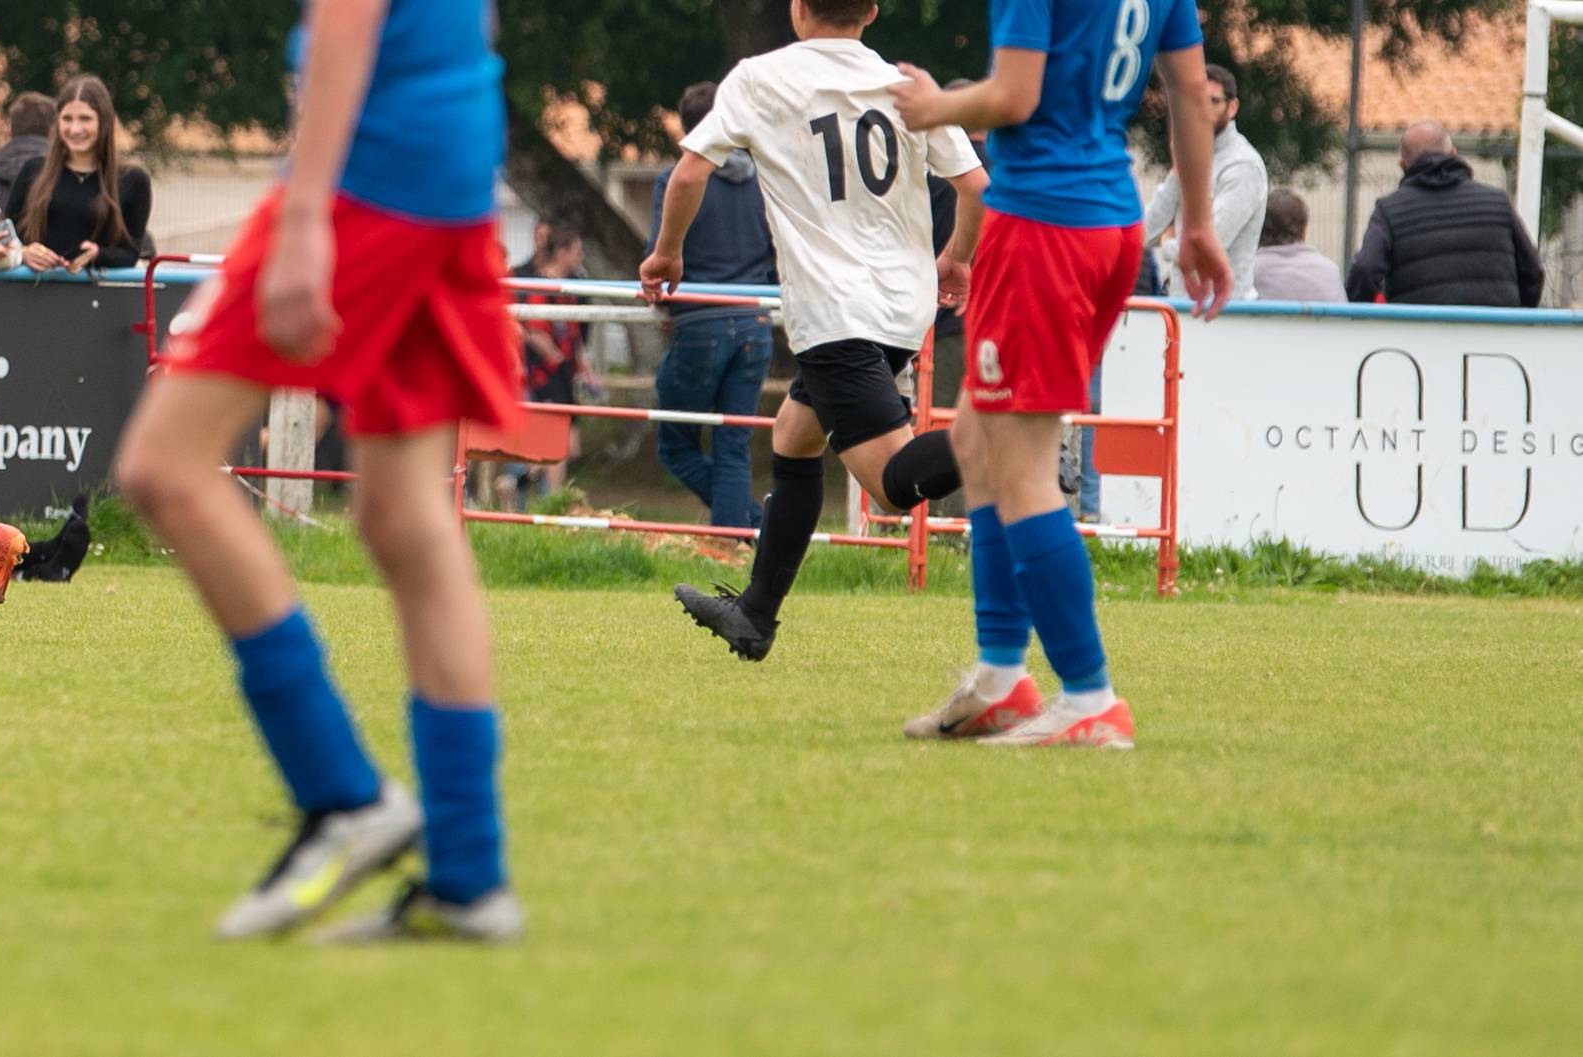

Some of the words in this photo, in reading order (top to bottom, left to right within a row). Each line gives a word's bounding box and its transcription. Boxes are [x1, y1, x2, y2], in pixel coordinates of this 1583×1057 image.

[809, 109, 898, 202] 10
[978, 339, 1003, 383] 8
[1266, 425, 1426, 453] OCTANT
